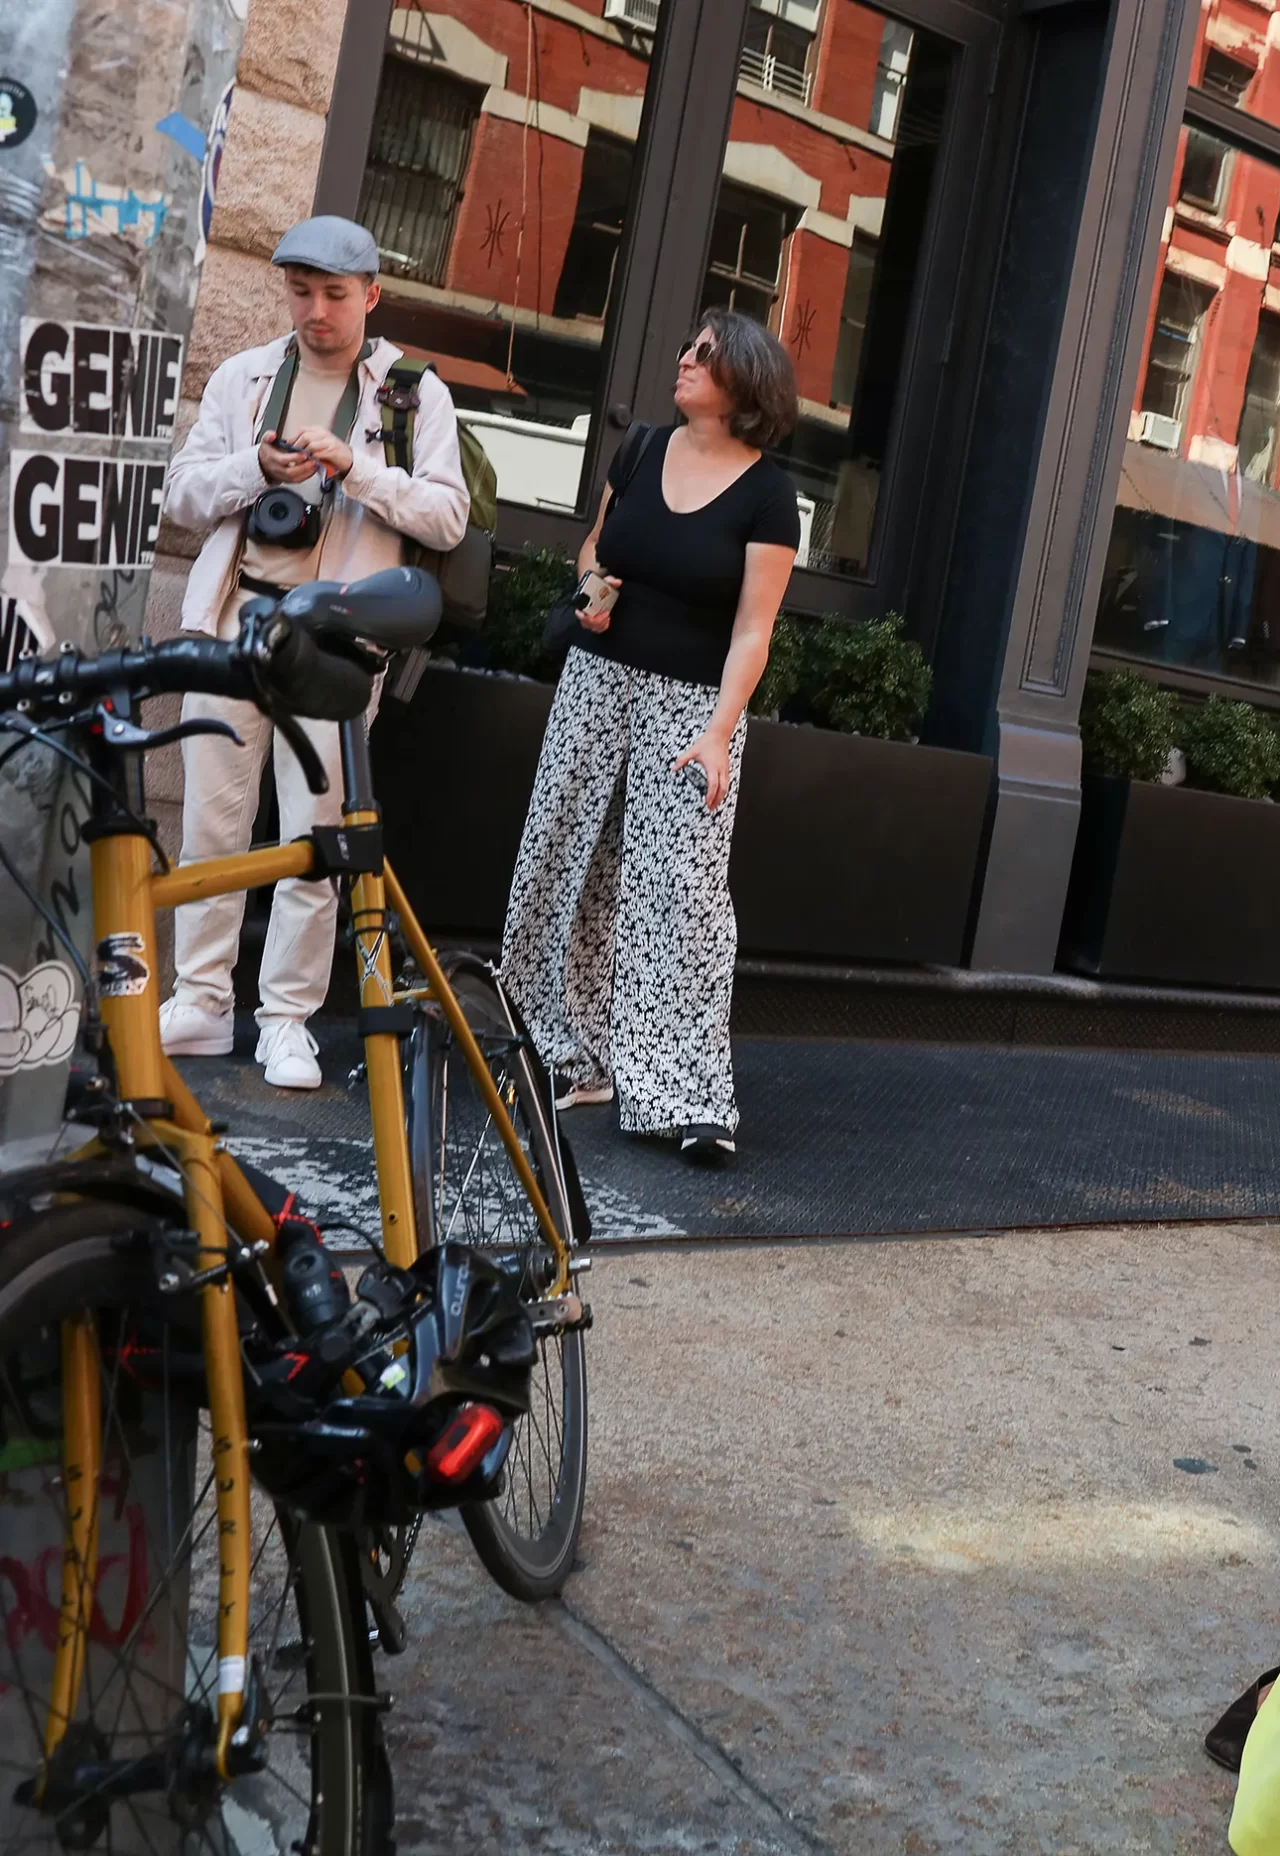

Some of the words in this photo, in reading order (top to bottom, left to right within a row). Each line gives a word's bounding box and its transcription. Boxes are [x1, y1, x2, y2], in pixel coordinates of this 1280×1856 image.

[24, 321, 182, 438] GENIE
[14, 454, 166, 566] GENIE
[214, 1435, 237, 1618] SURLY
